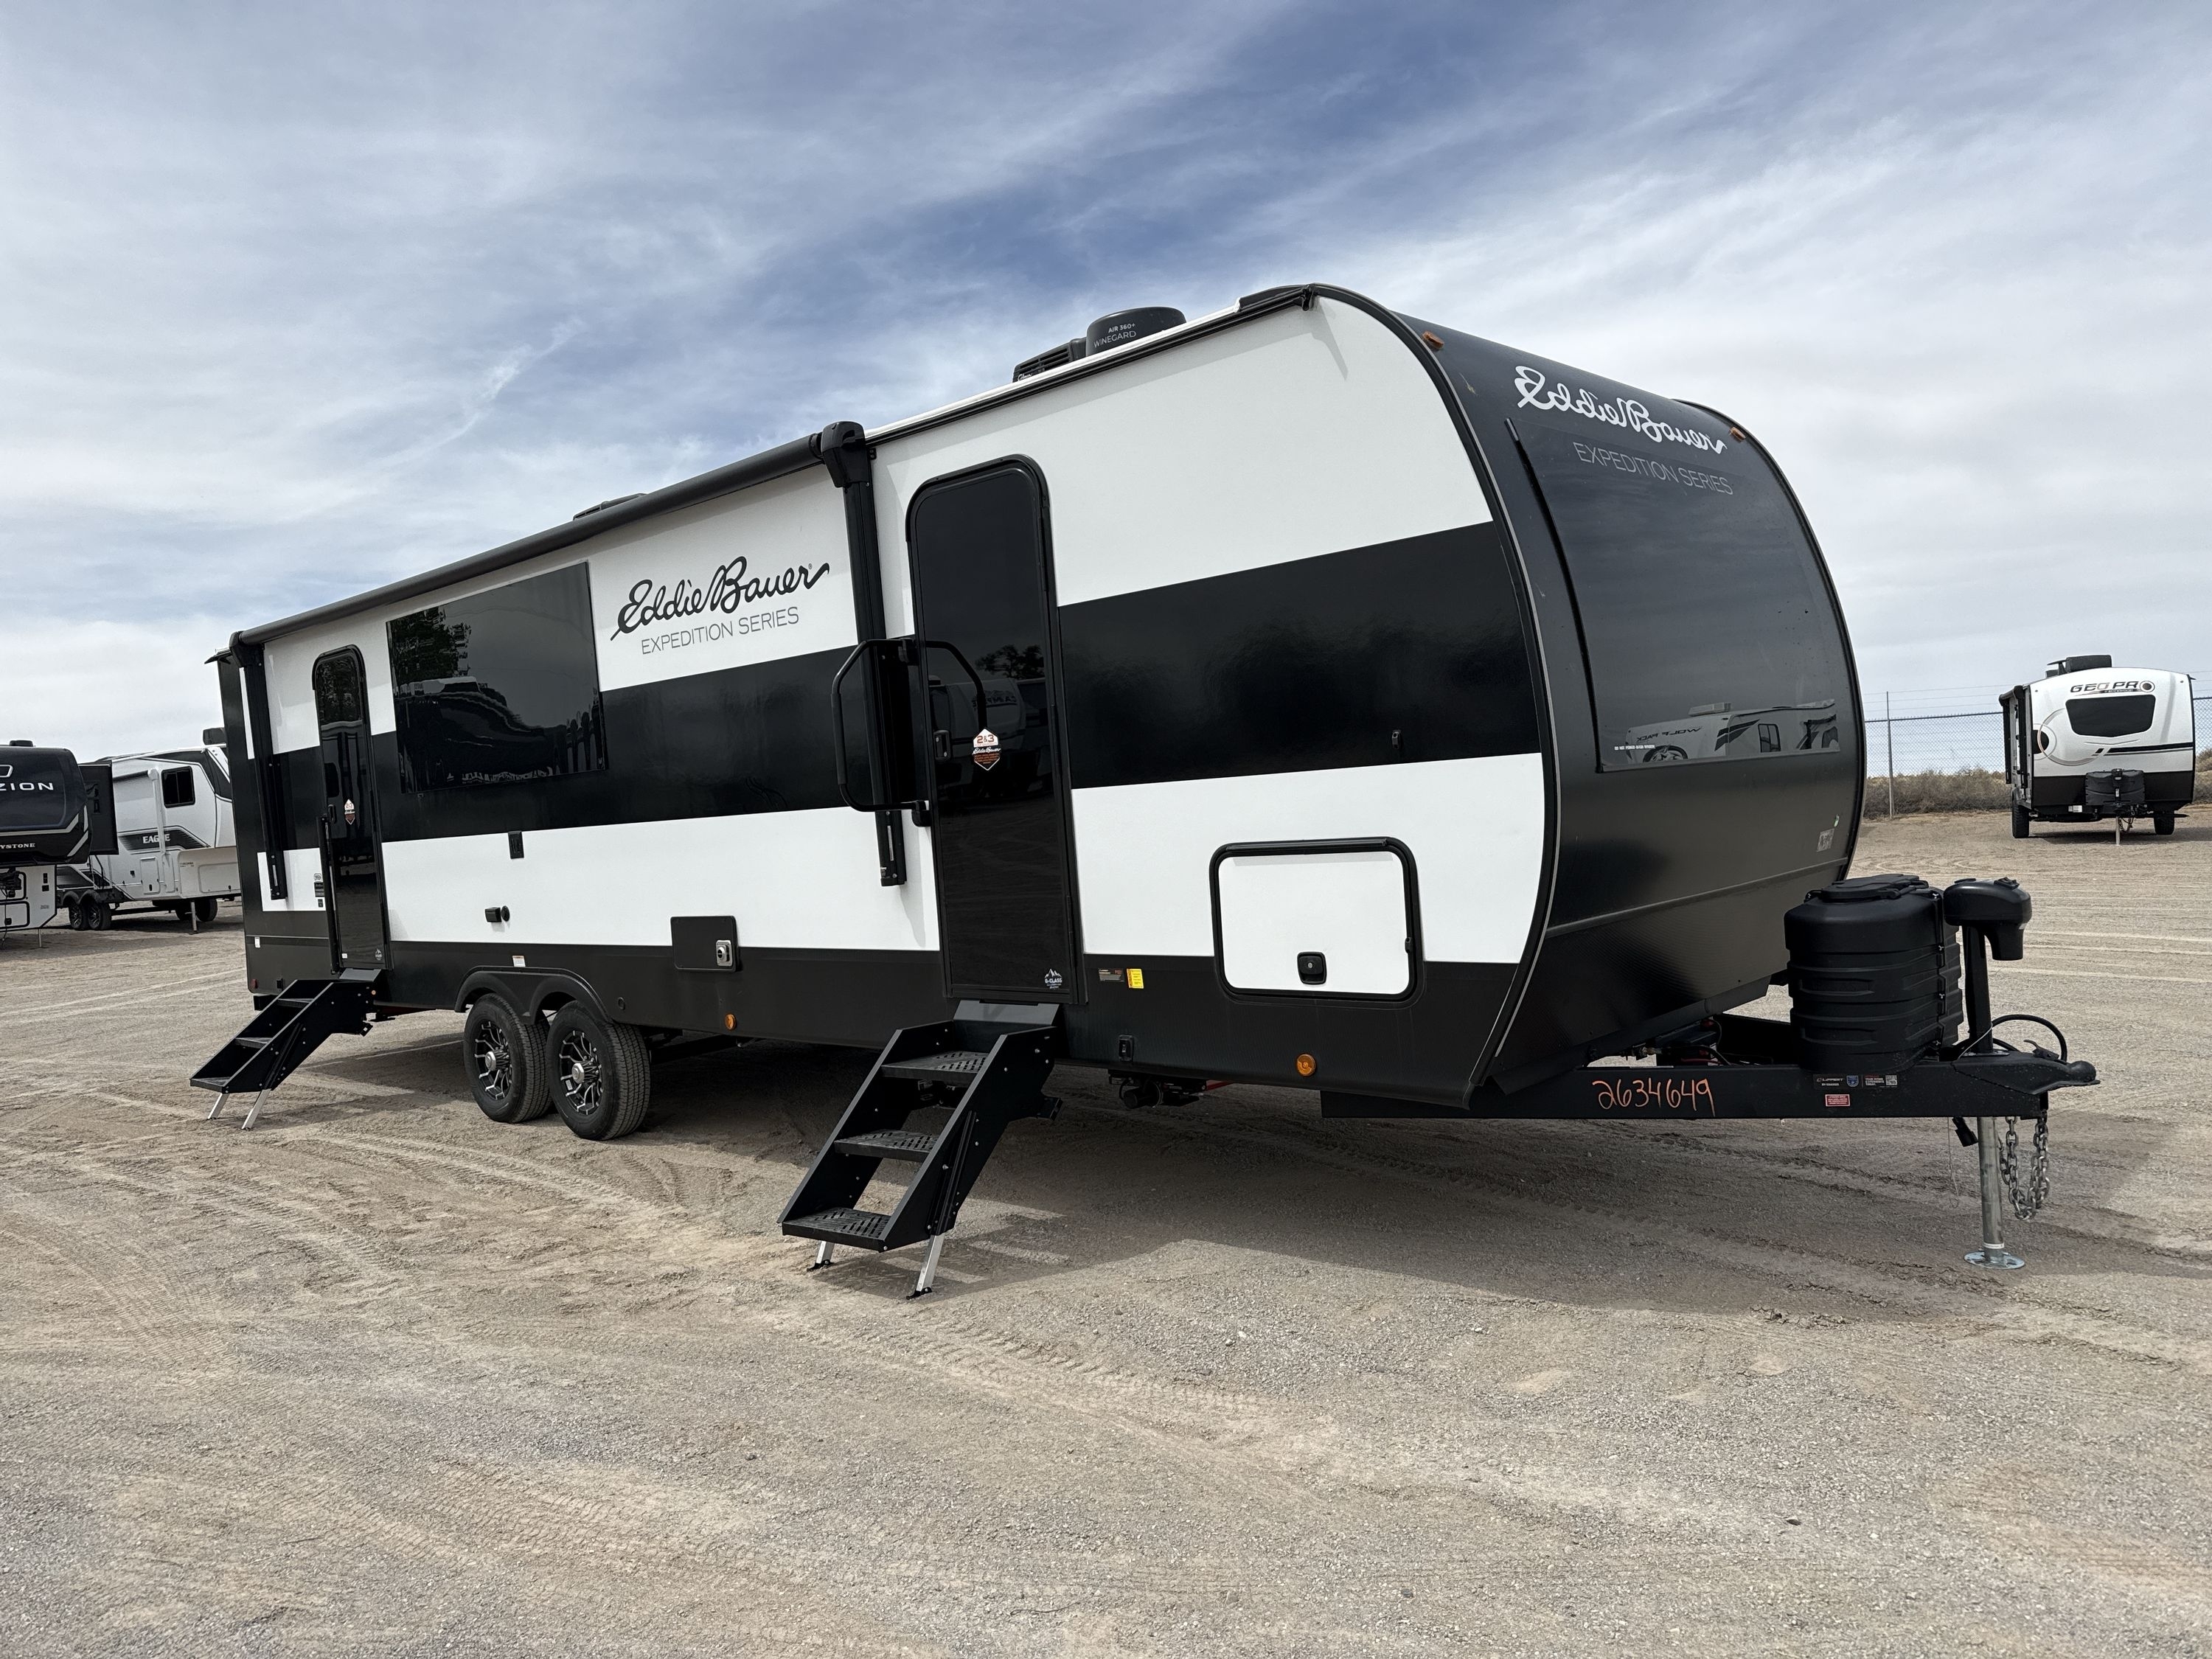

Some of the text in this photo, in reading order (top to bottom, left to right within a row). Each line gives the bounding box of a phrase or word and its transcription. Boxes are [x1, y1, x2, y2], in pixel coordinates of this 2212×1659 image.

[1120, 323, 1135, 331] 360+
[1093, 330, 1136, 348] WINEGARD
[1572, 442, 1733, 495] EXPEDITION SERIES
[641, 606, 799, 655] EXPEDITION SERIES
[2070, 682, 2110, 693] GEO
[142, 833, 171, 844] EAGE
[1591, 1076, 1716, 1117] 2634649
